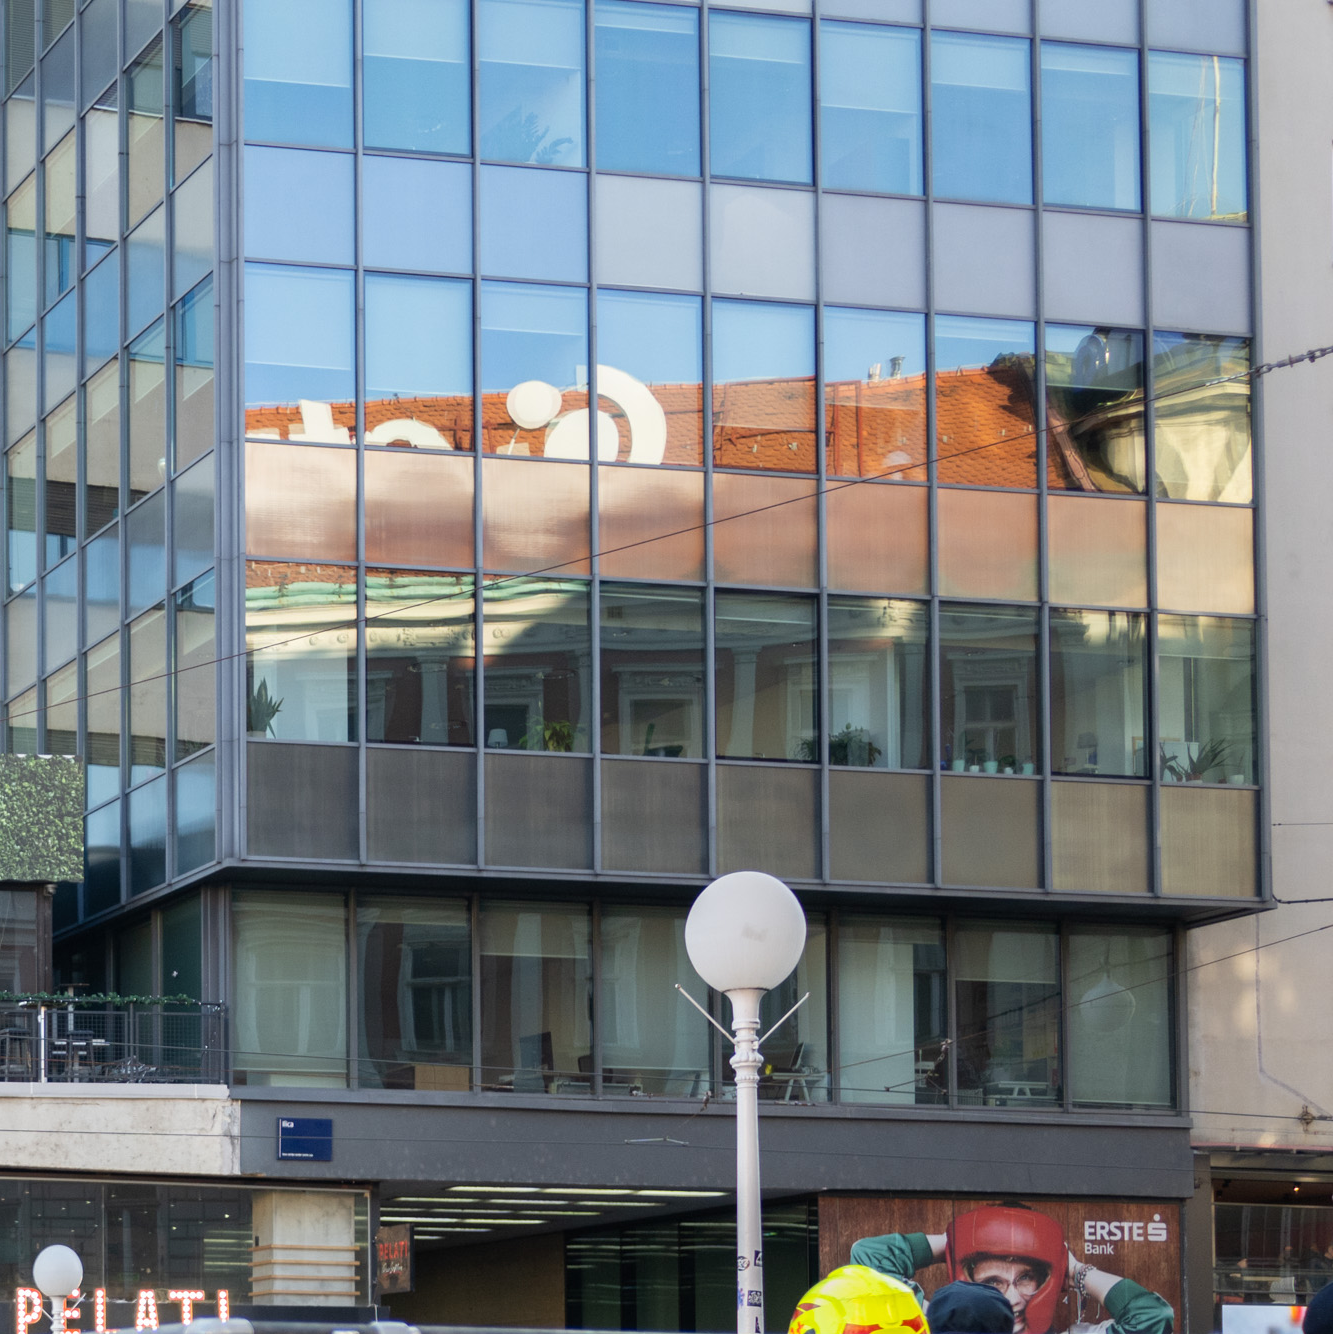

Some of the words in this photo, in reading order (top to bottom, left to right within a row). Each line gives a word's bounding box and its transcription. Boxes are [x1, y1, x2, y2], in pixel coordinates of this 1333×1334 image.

[1084, 1221, 1144, 1241] ERSTE
[379, 1240, 408, 1260] PELATI
[1085, 1242, 1114, 1254] Bank
